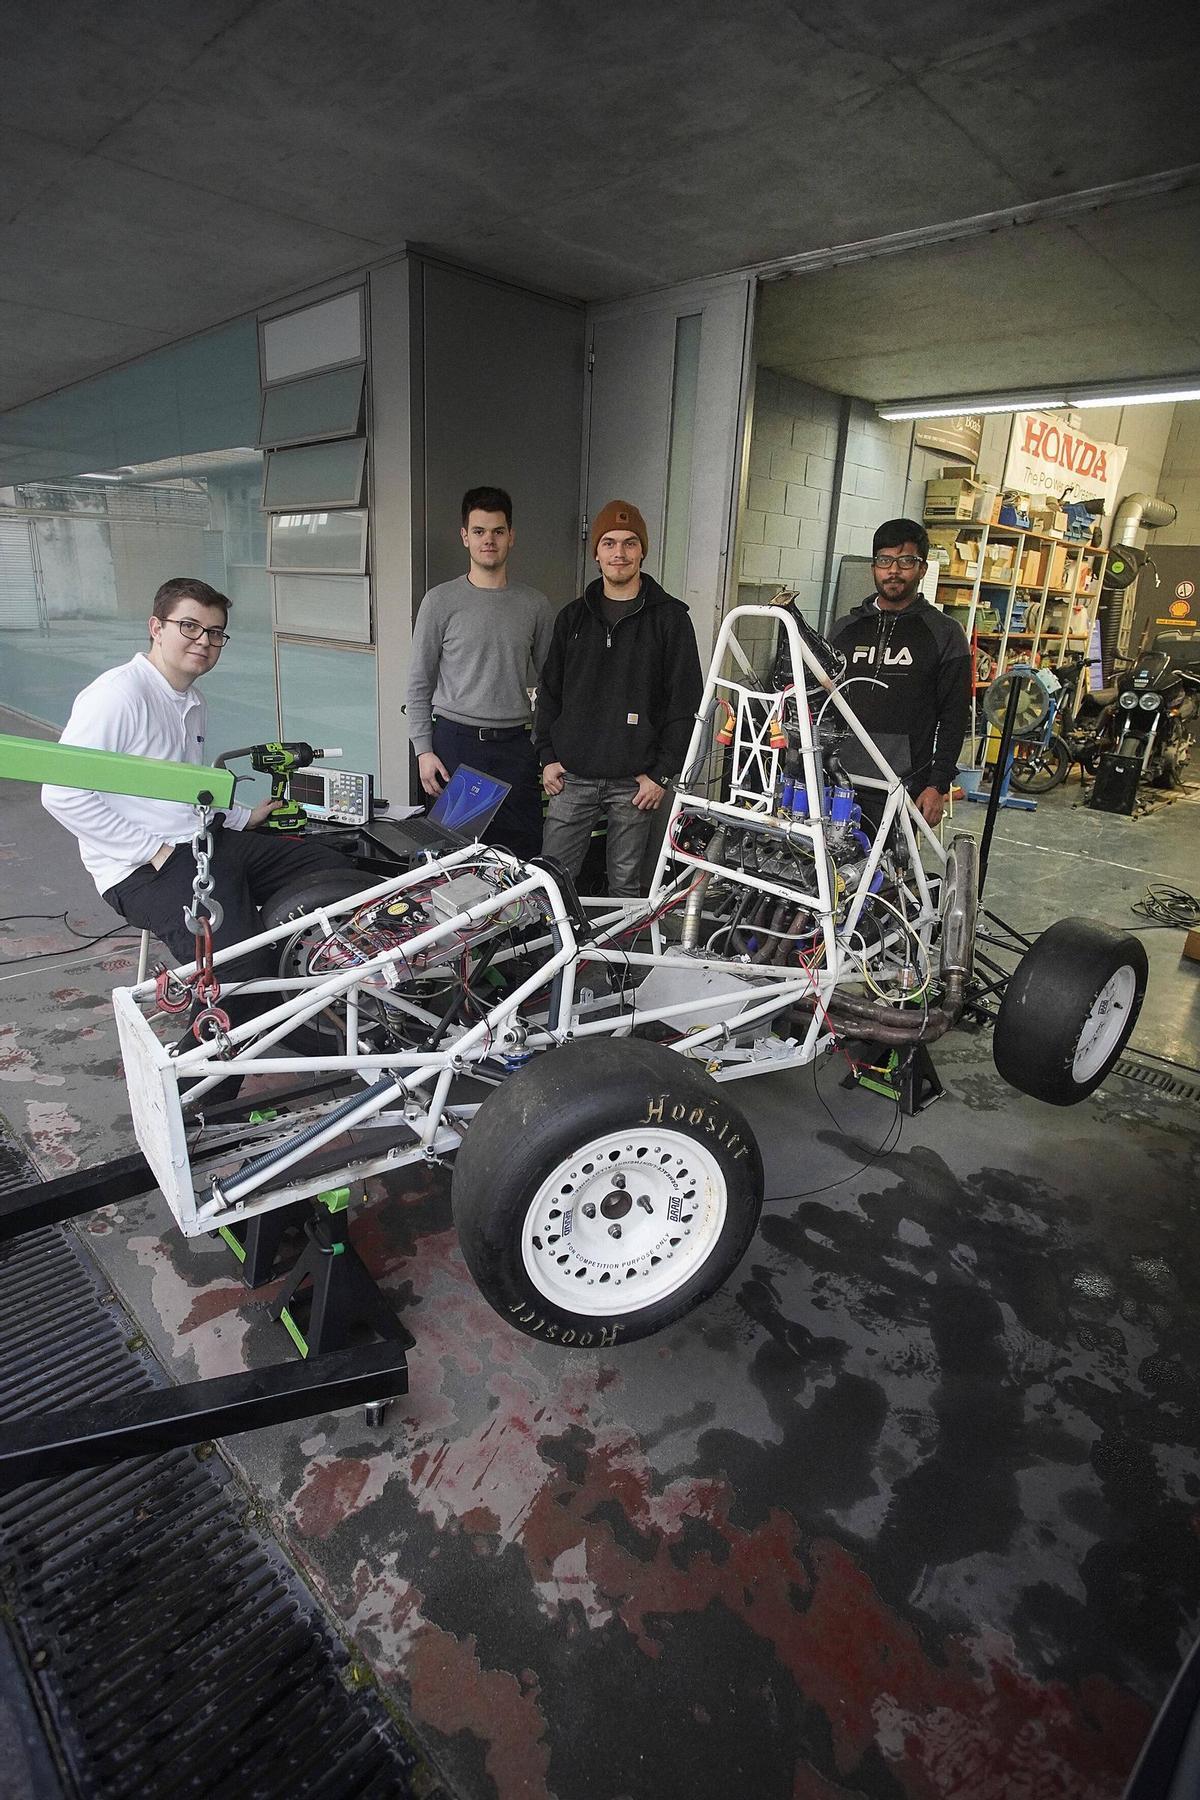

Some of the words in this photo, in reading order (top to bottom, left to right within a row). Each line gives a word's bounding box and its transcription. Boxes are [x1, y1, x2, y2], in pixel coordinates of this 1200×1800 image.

[1021, 416, 1107, 483] HONDA
[1024, 466, 1037, 486] The
[852, 646, 913, 665] FILA
[670, 1196, 681, 1223] BRAID
[566, 1242, 577, 1255] FOR
[575, 1253, 619, 1269] COMPETITION
[621, 1249, 655, 1268] PURPOSE
[655, 1233, 671, 1250] ONLY
